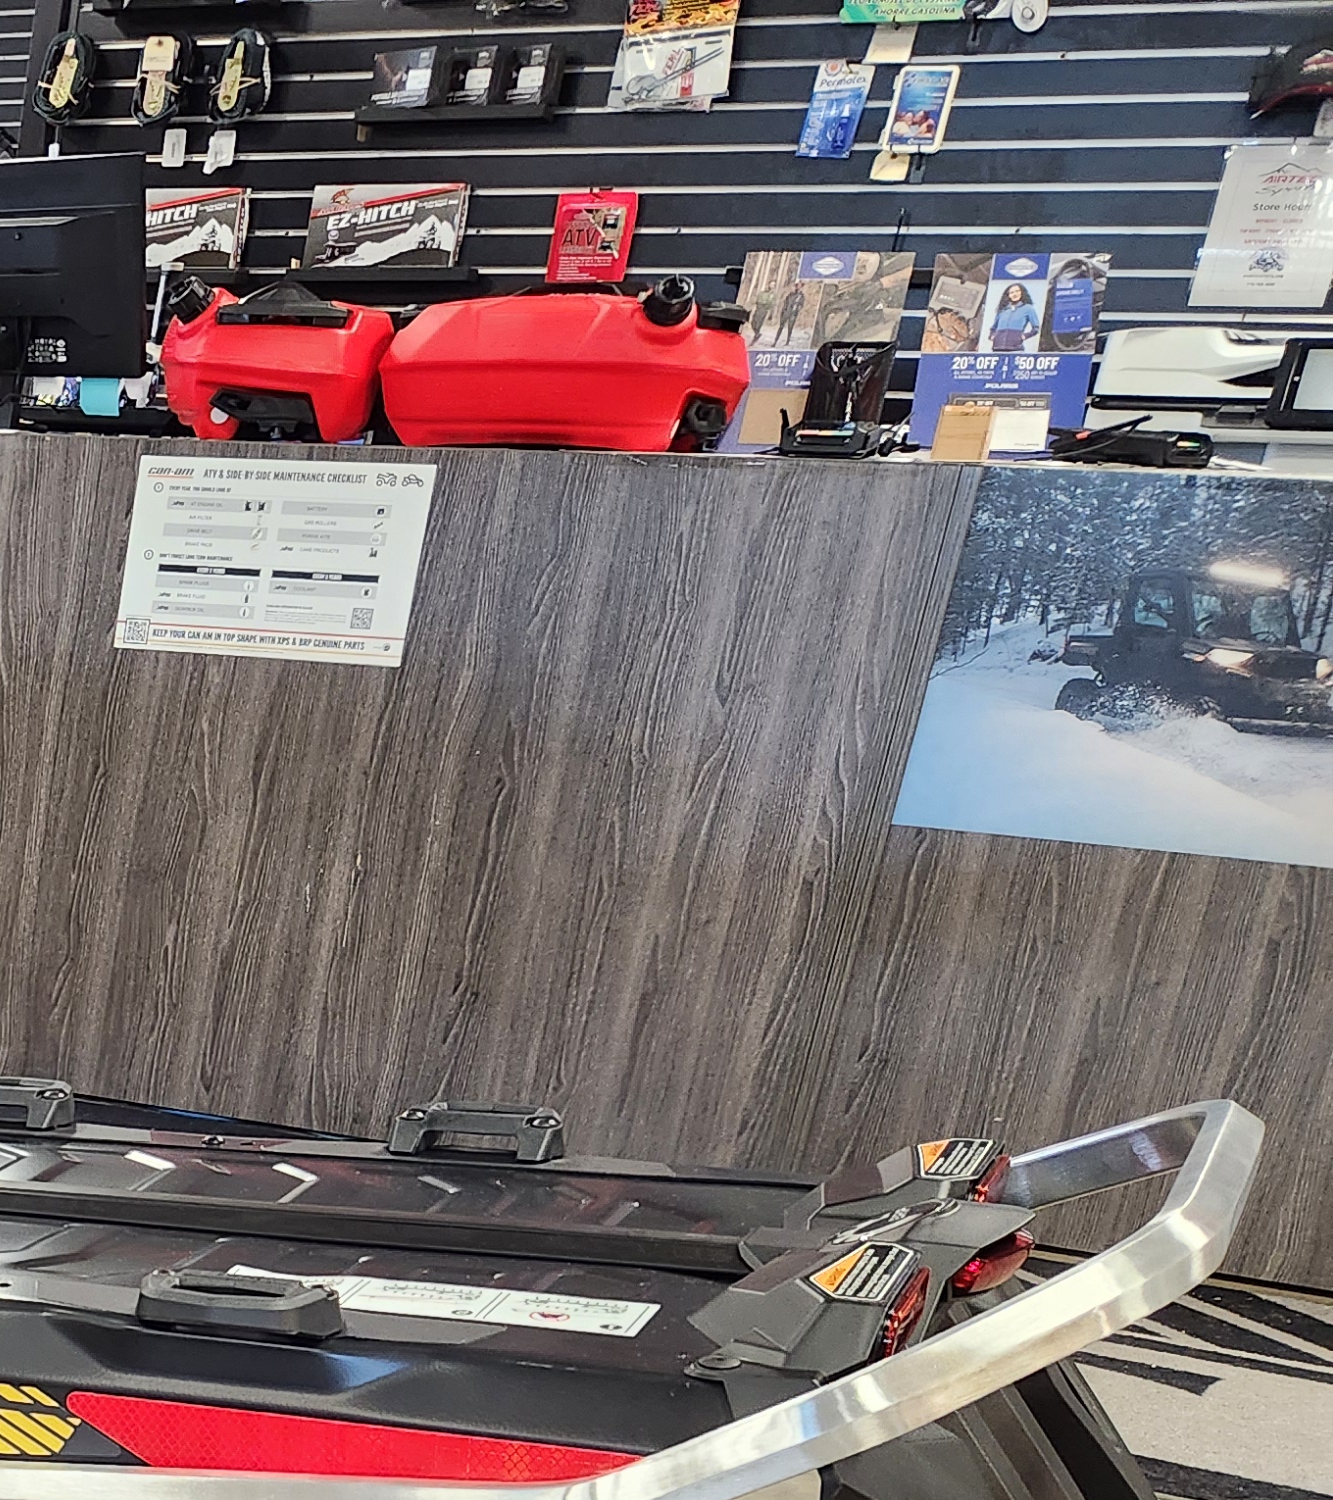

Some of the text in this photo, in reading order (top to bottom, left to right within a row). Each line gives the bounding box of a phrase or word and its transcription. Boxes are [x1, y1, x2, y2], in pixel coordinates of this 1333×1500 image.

[1253, 203, 1313, 212] Store Hour
[327, 200, 416, 231] EZ-HITCH
[562, 229, 598, 246] ATV
[777, 354, 801, 367] OFF
[976, 356, 1000, 370] OFF
[1014, 356, 1060, 370] $50 OFF
[203, 470, 217, 479] ATV
[273, 471, 326, 482] MAINTENANCE
[327, 473, 368, 484] CHECKLIST
[152, 628, 168, 638] KEEP
[169, 629, 186, 639] YOUR
[214, 632, 221, 641] IN
[223, 633, 235, 642] TOP
[237, 633, 257, 643] SHAPE
[259, 634, 275, 644] WITH
[277, 636, 290, 645] XPS
[298, 637, 312, 646] BRP
[313, 638, 342, 648] GENUINE
[343, 640, 365, 650] PARTS
